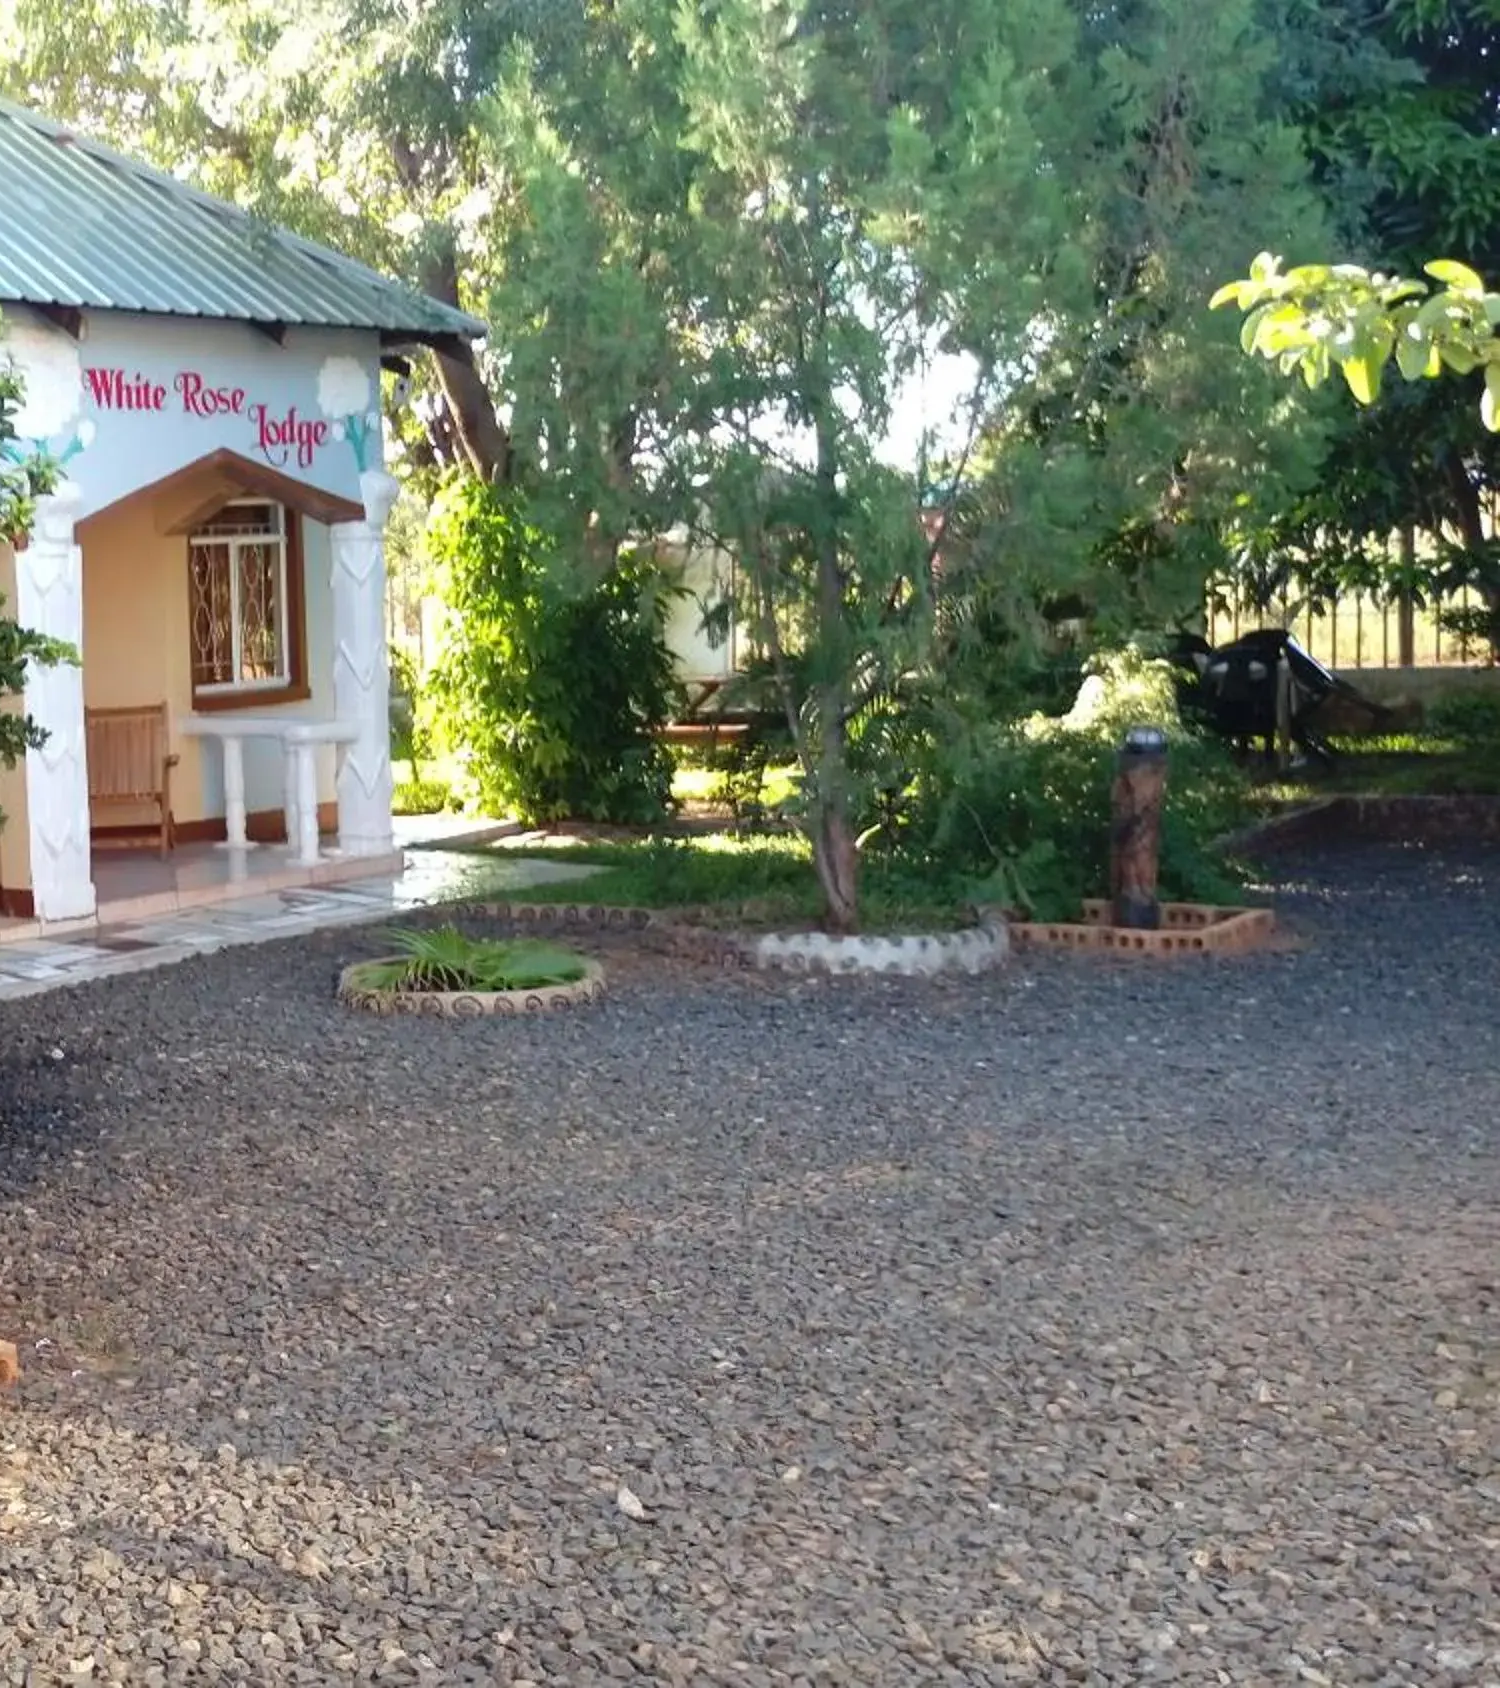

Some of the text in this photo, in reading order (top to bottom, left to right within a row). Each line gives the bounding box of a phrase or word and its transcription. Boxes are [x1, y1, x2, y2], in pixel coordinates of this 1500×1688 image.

[83, 367, 245, 418] White Rose
[247, 403, 328, 468] Lodge
